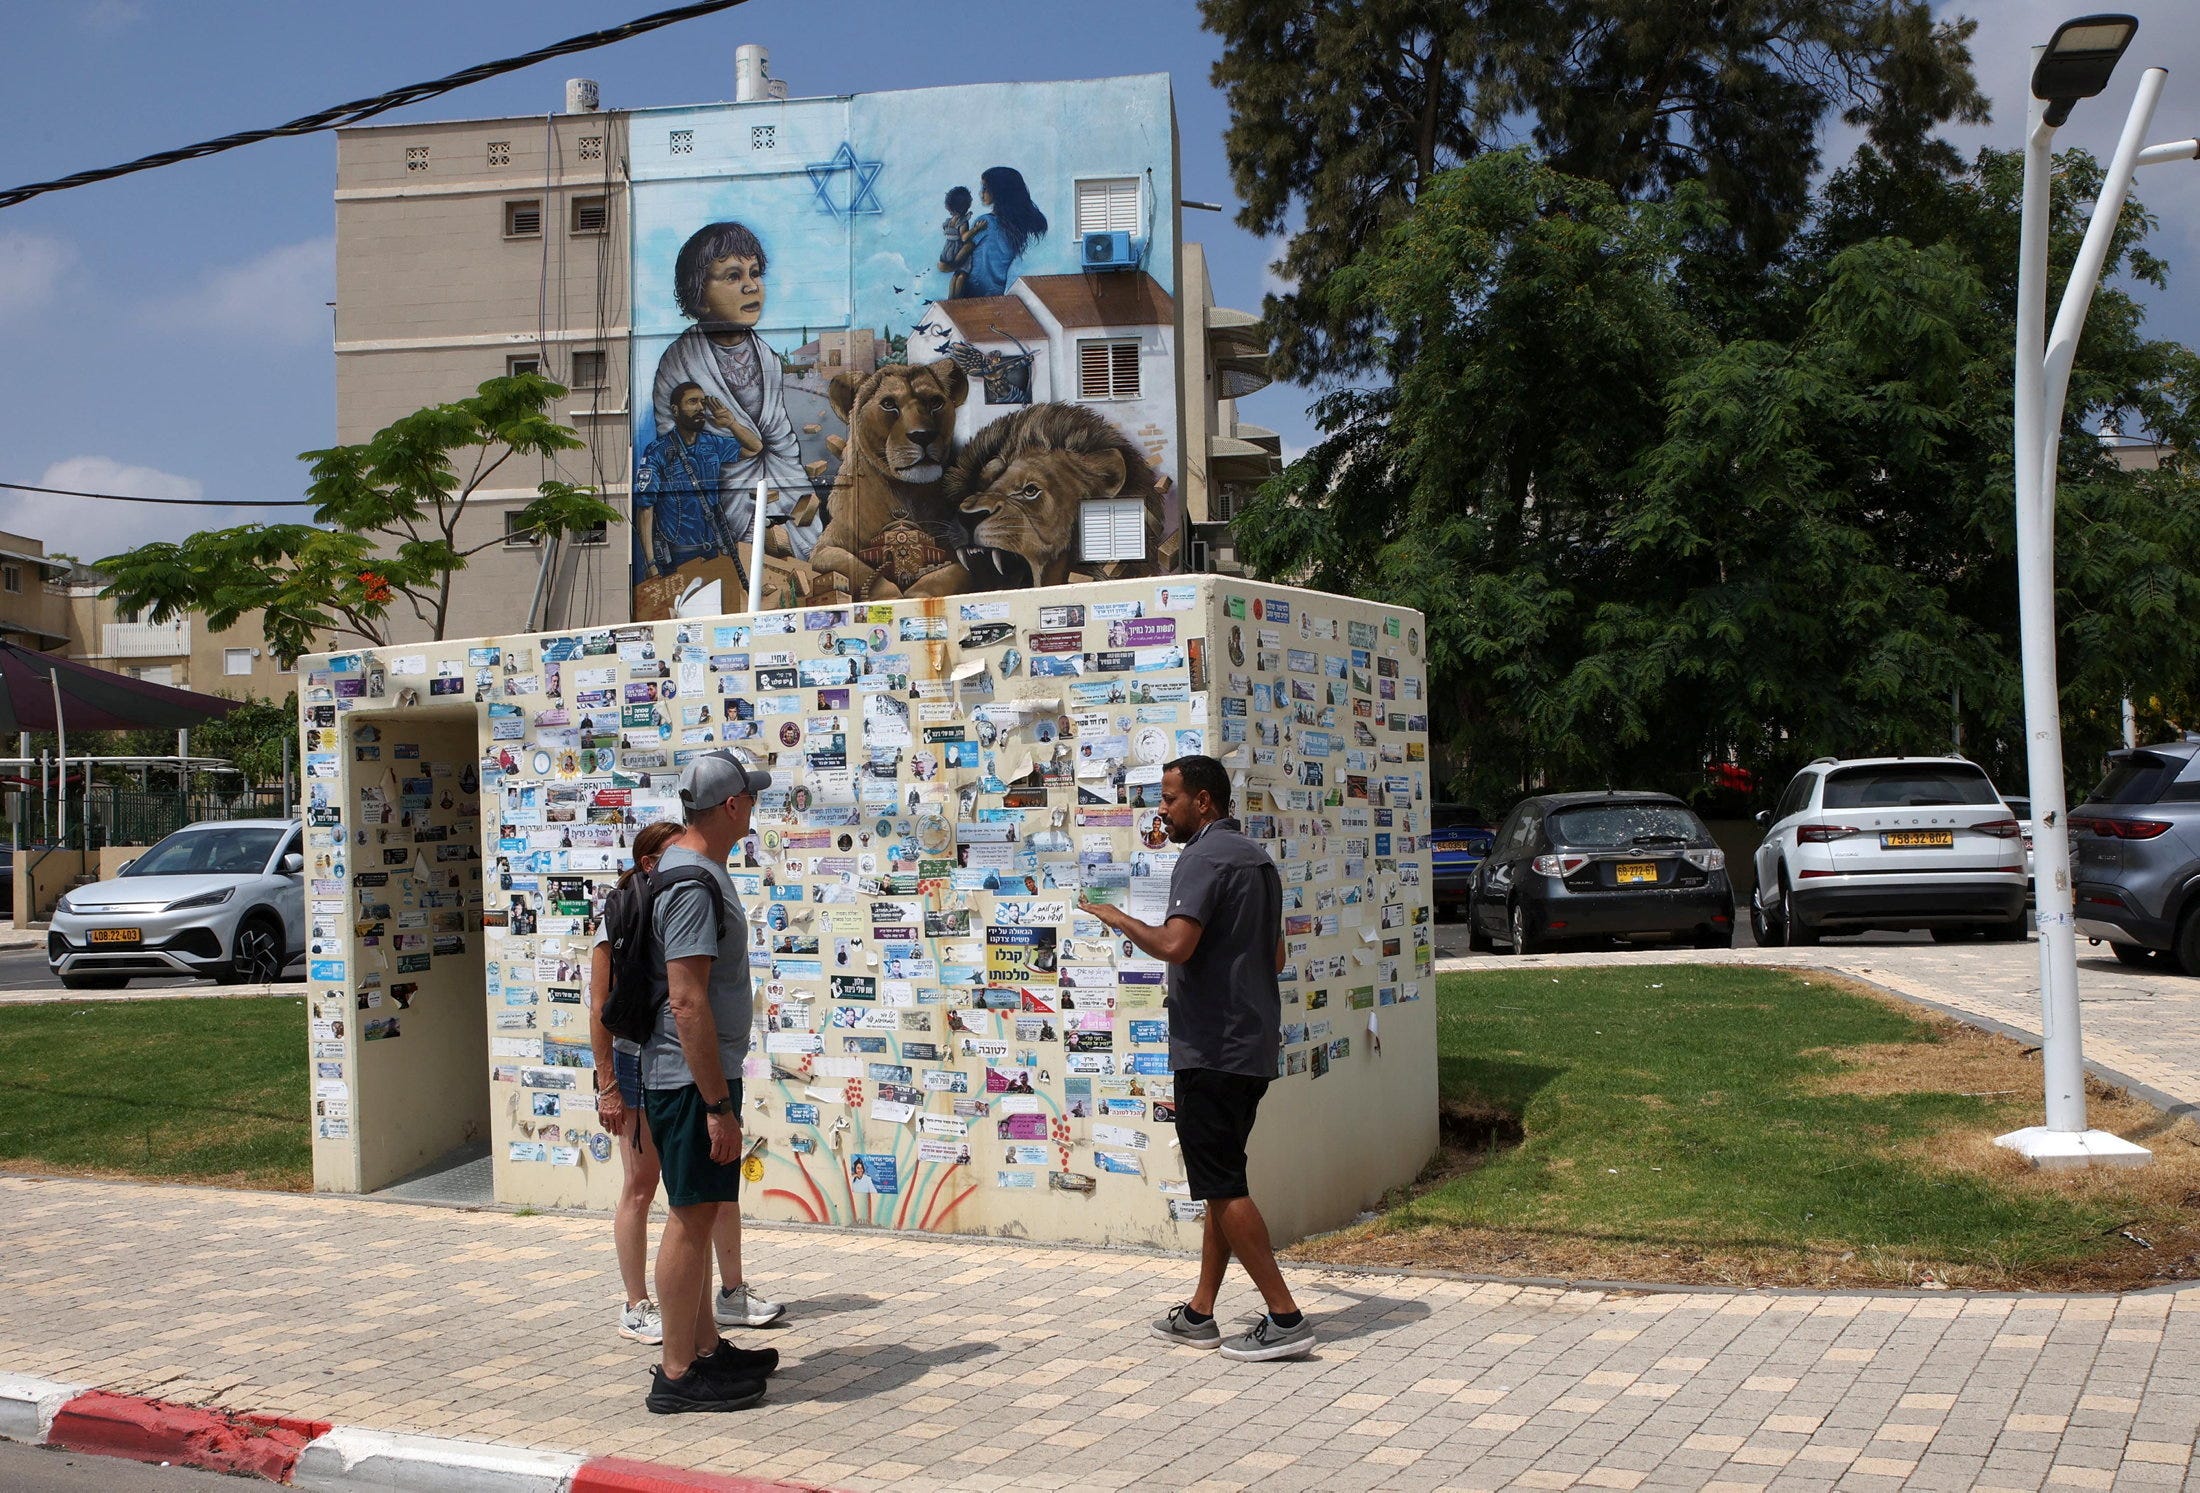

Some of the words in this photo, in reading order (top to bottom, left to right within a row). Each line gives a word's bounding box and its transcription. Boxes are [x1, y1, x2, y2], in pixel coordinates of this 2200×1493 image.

[999, 927, 1007, 935] על
[1009, 927, 1033, 935] הגאולה
[990, 936, 1009, 944] צדקנו
[995, 948, 1022, 963] קבלו
[989, 968, 1030, 980] מלכותו
[978, 1045, 1007, 1054] לטובה
